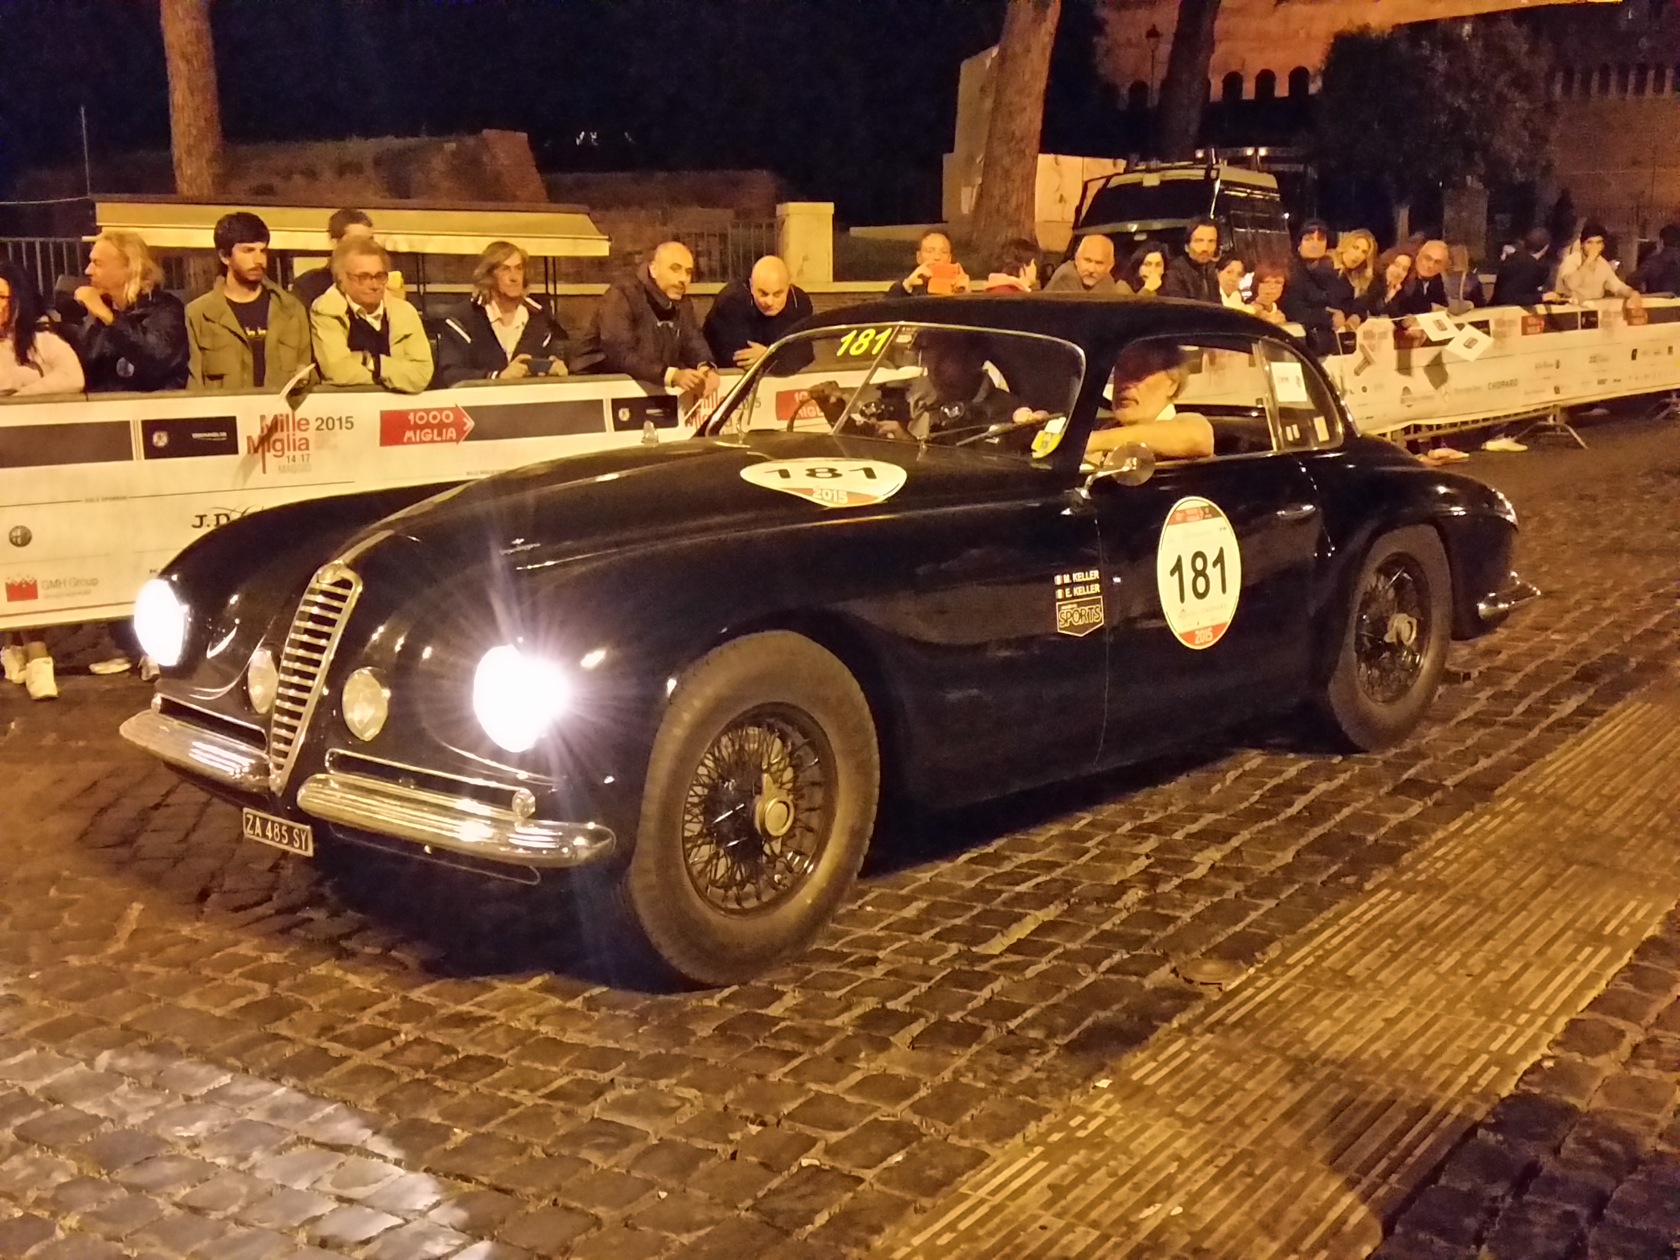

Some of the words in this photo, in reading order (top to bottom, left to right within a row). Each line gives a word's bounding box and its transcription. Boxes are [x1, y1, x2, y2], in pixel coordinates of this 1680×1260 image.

[836, 327, 893, 357] 181
[259, 413, 311, 433] Mille
[315, 415, 355, 431] 2015
[408, 410, 454, 425] 1000
[403, 427, 457, 443] MIGLIA
[246, 433, 311, 459] Miglia
[764, 466, 877, 480] 181
[812, 487, 849, 504] 2015
[41, 578, 67, 590] GMH
[69, 576, 99, 589] Group
[1072, 569, 1100, 583] KELLER
[1169, 546, 1227, 605] 181
[1065, 587, 1073, 598] E.
[1073, 583, 1101, 597] KELLER
[1059, 604, 1102, 628] SPORTS
[1195, 627, 1214, 645] 2015
[246, 814, 262, 838] ZA
[265, 820, 289, 845] 485
[292, 828, 307, 851] SY
